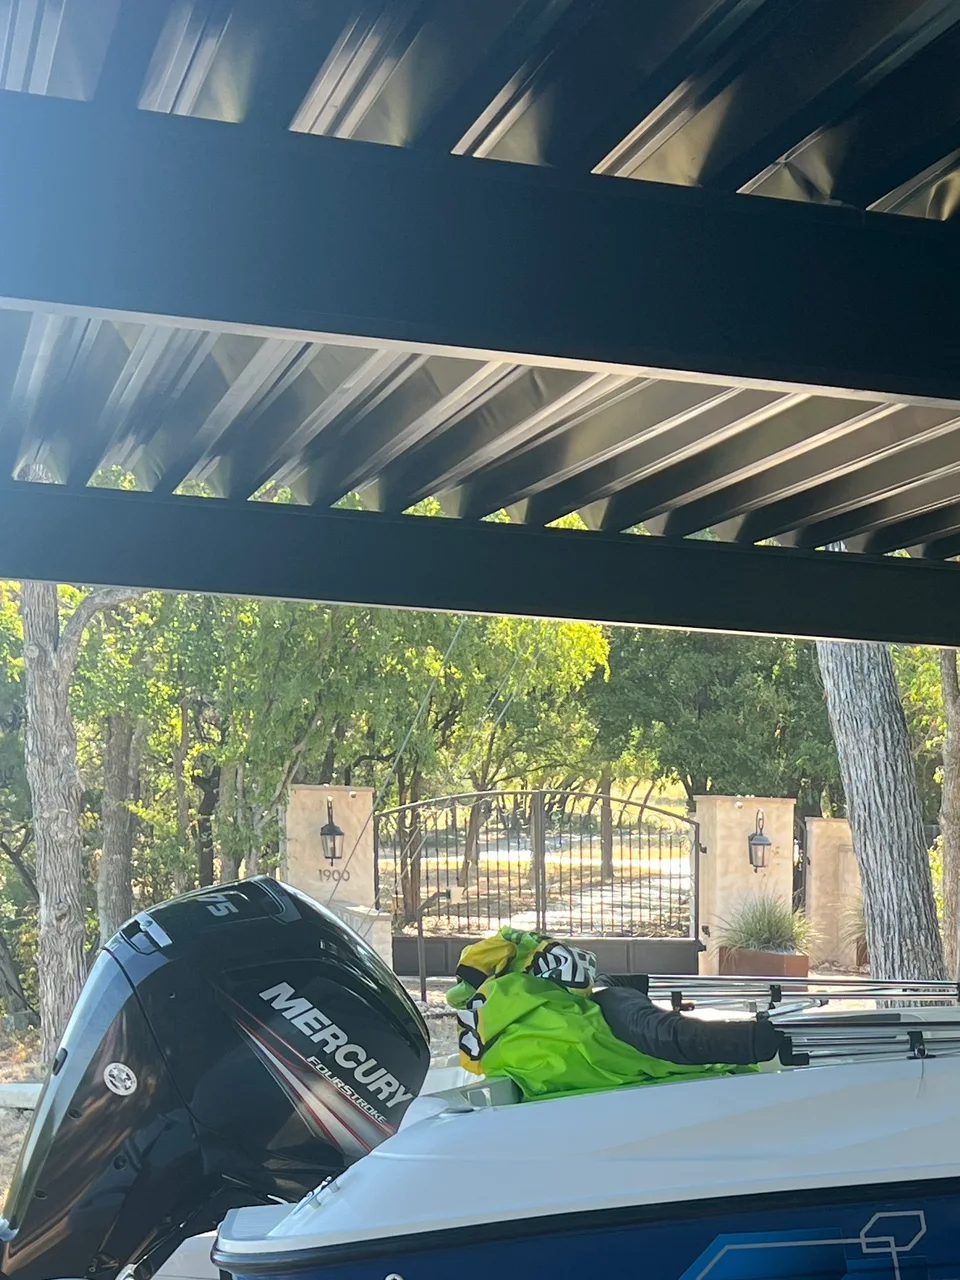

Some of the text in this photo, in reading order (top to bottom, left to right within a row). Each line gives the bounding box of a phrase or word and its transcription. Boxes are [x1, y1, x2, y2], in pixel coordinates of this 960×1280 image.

[319, 869, 351, 882] 1900
[258, 981, 414, 1109] MERCURY
[306, 1055, 388, 1125] FOURSTROKE
